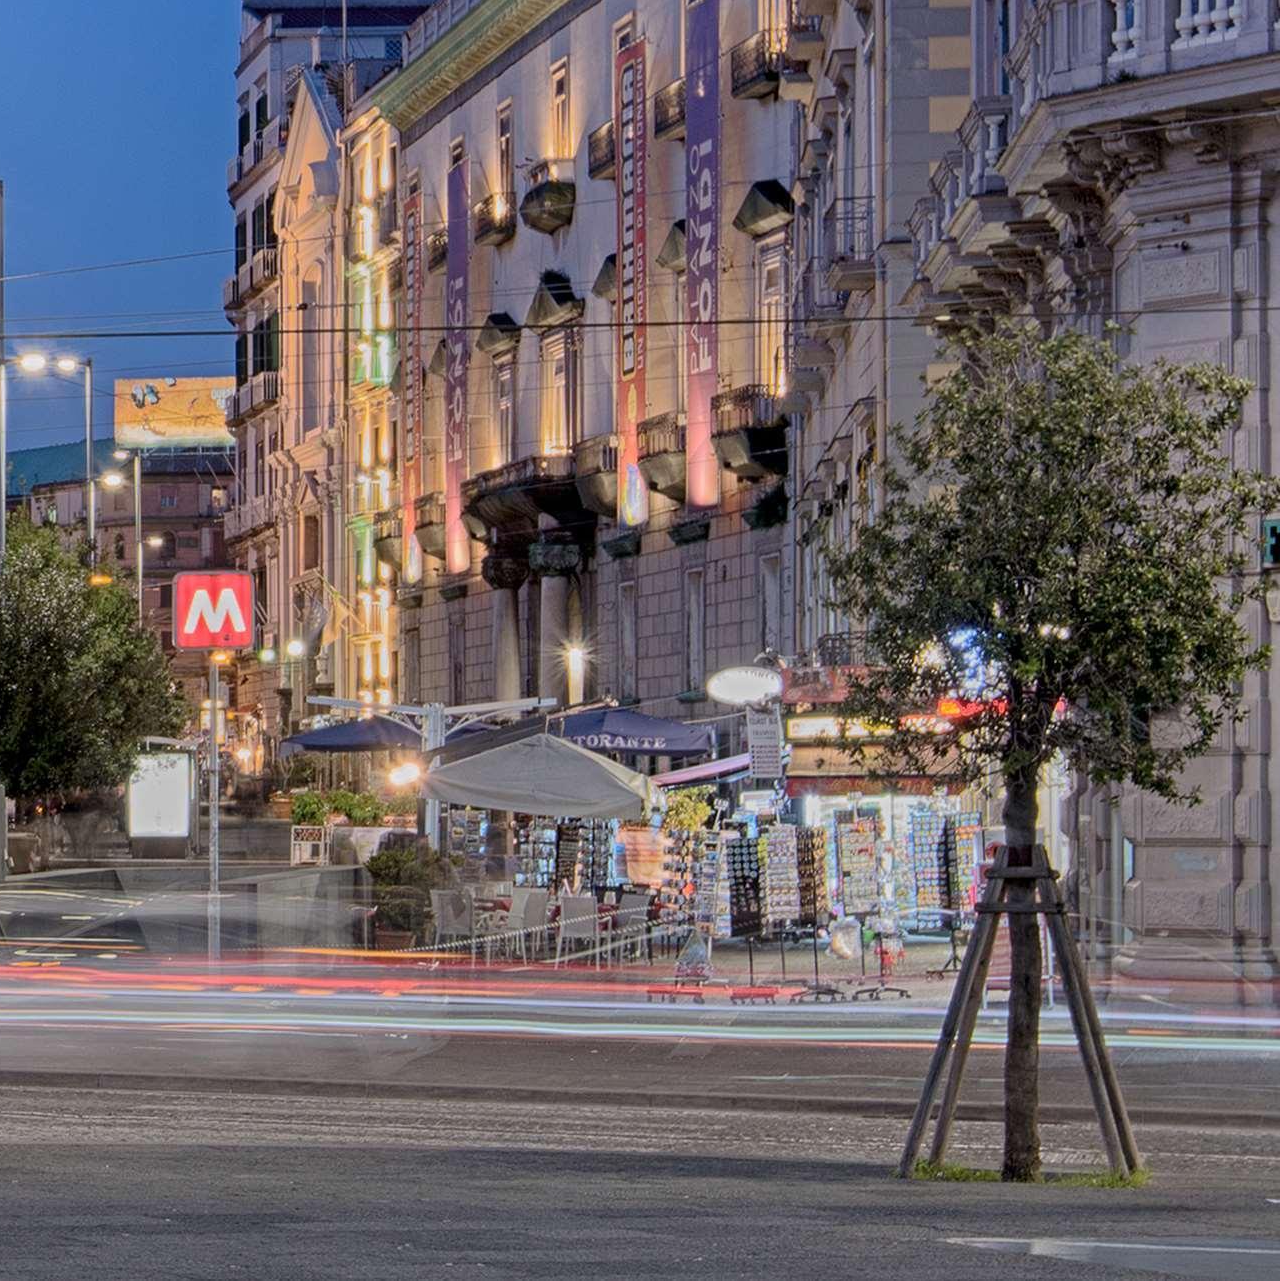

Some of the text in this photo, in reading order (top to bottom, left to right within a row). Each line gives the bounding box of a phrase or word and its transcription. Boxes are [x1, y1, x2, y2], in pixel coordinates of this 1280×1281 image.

[636, 206, 644, 229] DI
[636, 242, 644, 323] MONDO
[690, 144, 700, 374] PALAZZO
[699, 138, 713, 373] FONDI
[453, 276, 464, 460] FONDI
[636, 336, 644, 369] UN
[184, 588, 247, 633] M
[566, 733, 666, 748] TORANTE
